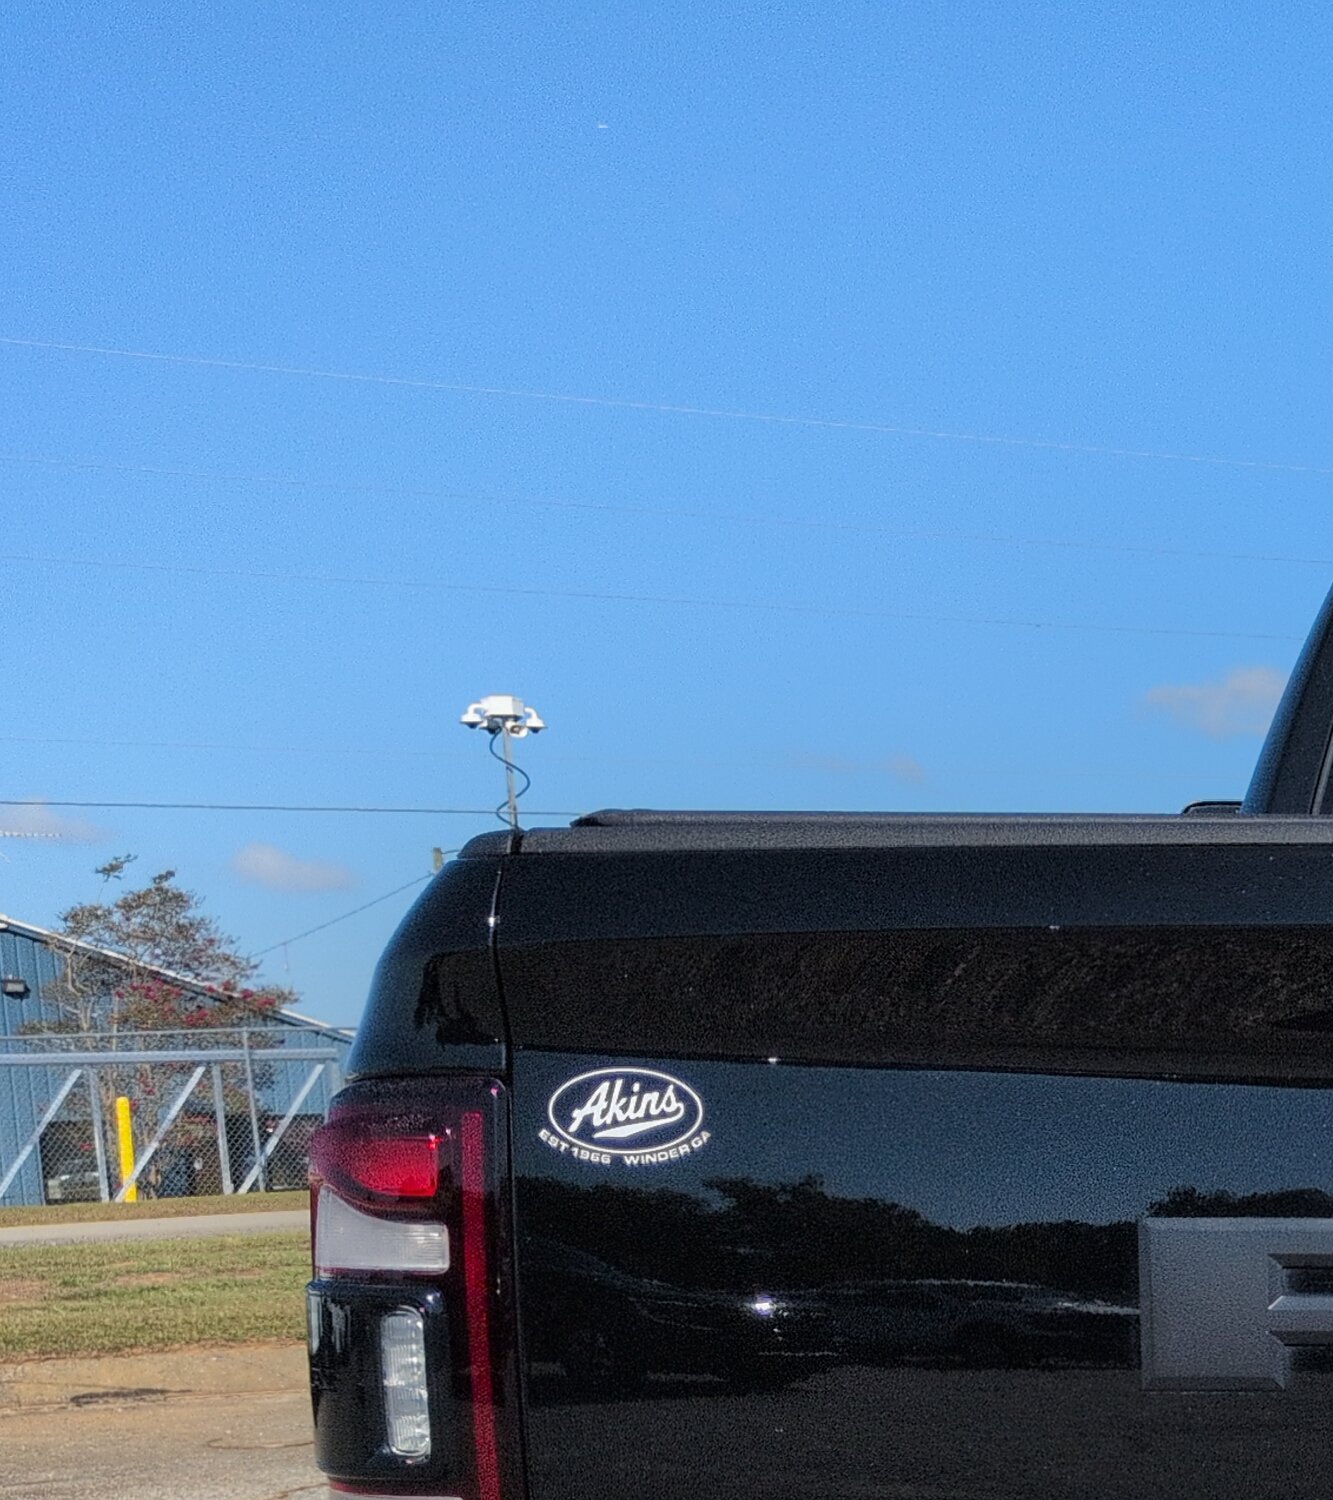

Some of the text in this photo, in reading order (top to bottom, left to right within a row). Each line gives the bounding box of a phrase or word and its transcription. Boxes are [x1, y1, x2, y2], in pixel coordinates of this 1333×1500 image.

[568, 1079, 684, 1137] Akins
[538, 1128, 571, 1152] EST
[623, 1145, 691, 1166] WINDER
[691, 1130, 712, 1148] GA
